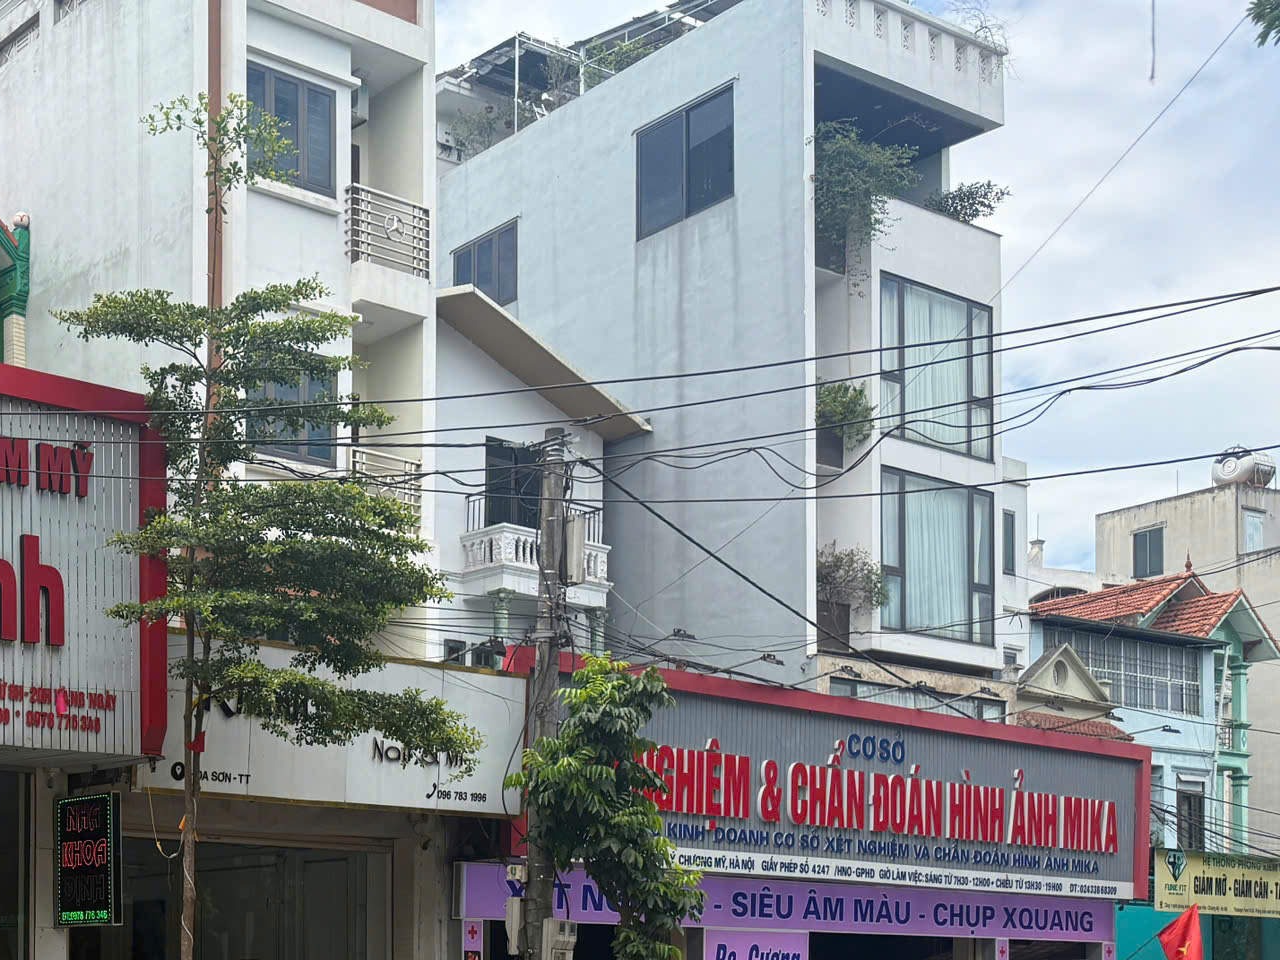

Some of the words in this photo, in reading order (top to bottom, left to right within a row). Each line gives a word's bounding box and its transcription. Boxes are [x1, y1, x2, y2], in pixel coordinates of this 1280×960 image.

[36, 441, 95, 498] MỸ
[437, 790, 451, 800] 096
[454, 791, 468, 801] 783
[470, 792, 487, 802] 1996
[758, 759, 782, 824] &
[787, 739, 865, 830] CHẨN
[869, 764, 942, 838] ĐOÁN
[946, 769, 1005, 843] HÌNH
[1006, 768, 1057, 848] ẢNH
[1060, 796, 1118, 854] MIKA
[62, 838, 107, 869] KHOA
[666, 823, 705, 841] KINH
[712, 827, 769, 847] DOANH
[773, 832, 795, 848] CƠ
[800, 829, 819, 849] SỞ
[824, 835, 852, 853] XÉT
[857, 838, 910, 860] NGHIỆM
[912, 844, 929, 860] VÀ
[972, 847, 1009, 866] ĐOÁN
[1012, 850, 1040, 869] HÌNH
[1070, 859, 1099, 874] MIKA
[729, 856, 741, 870] HÀ
[741, 856, 754, 872] NỘI
[780, 858, 798, 873] PHÉP
[812, 864, 829, 875] 4247
[891, 868, 907, 881] LÀM
[506, 880, 571, 909] XT
[732, 887, 793, 919] SIÊU
[803, 889, 844, 921] ÂM
[854, 894, 910, 924] MÀU
[933, 902, 995, 935] CHỤP
[1002, 907, 1093, 932] XQUANG
